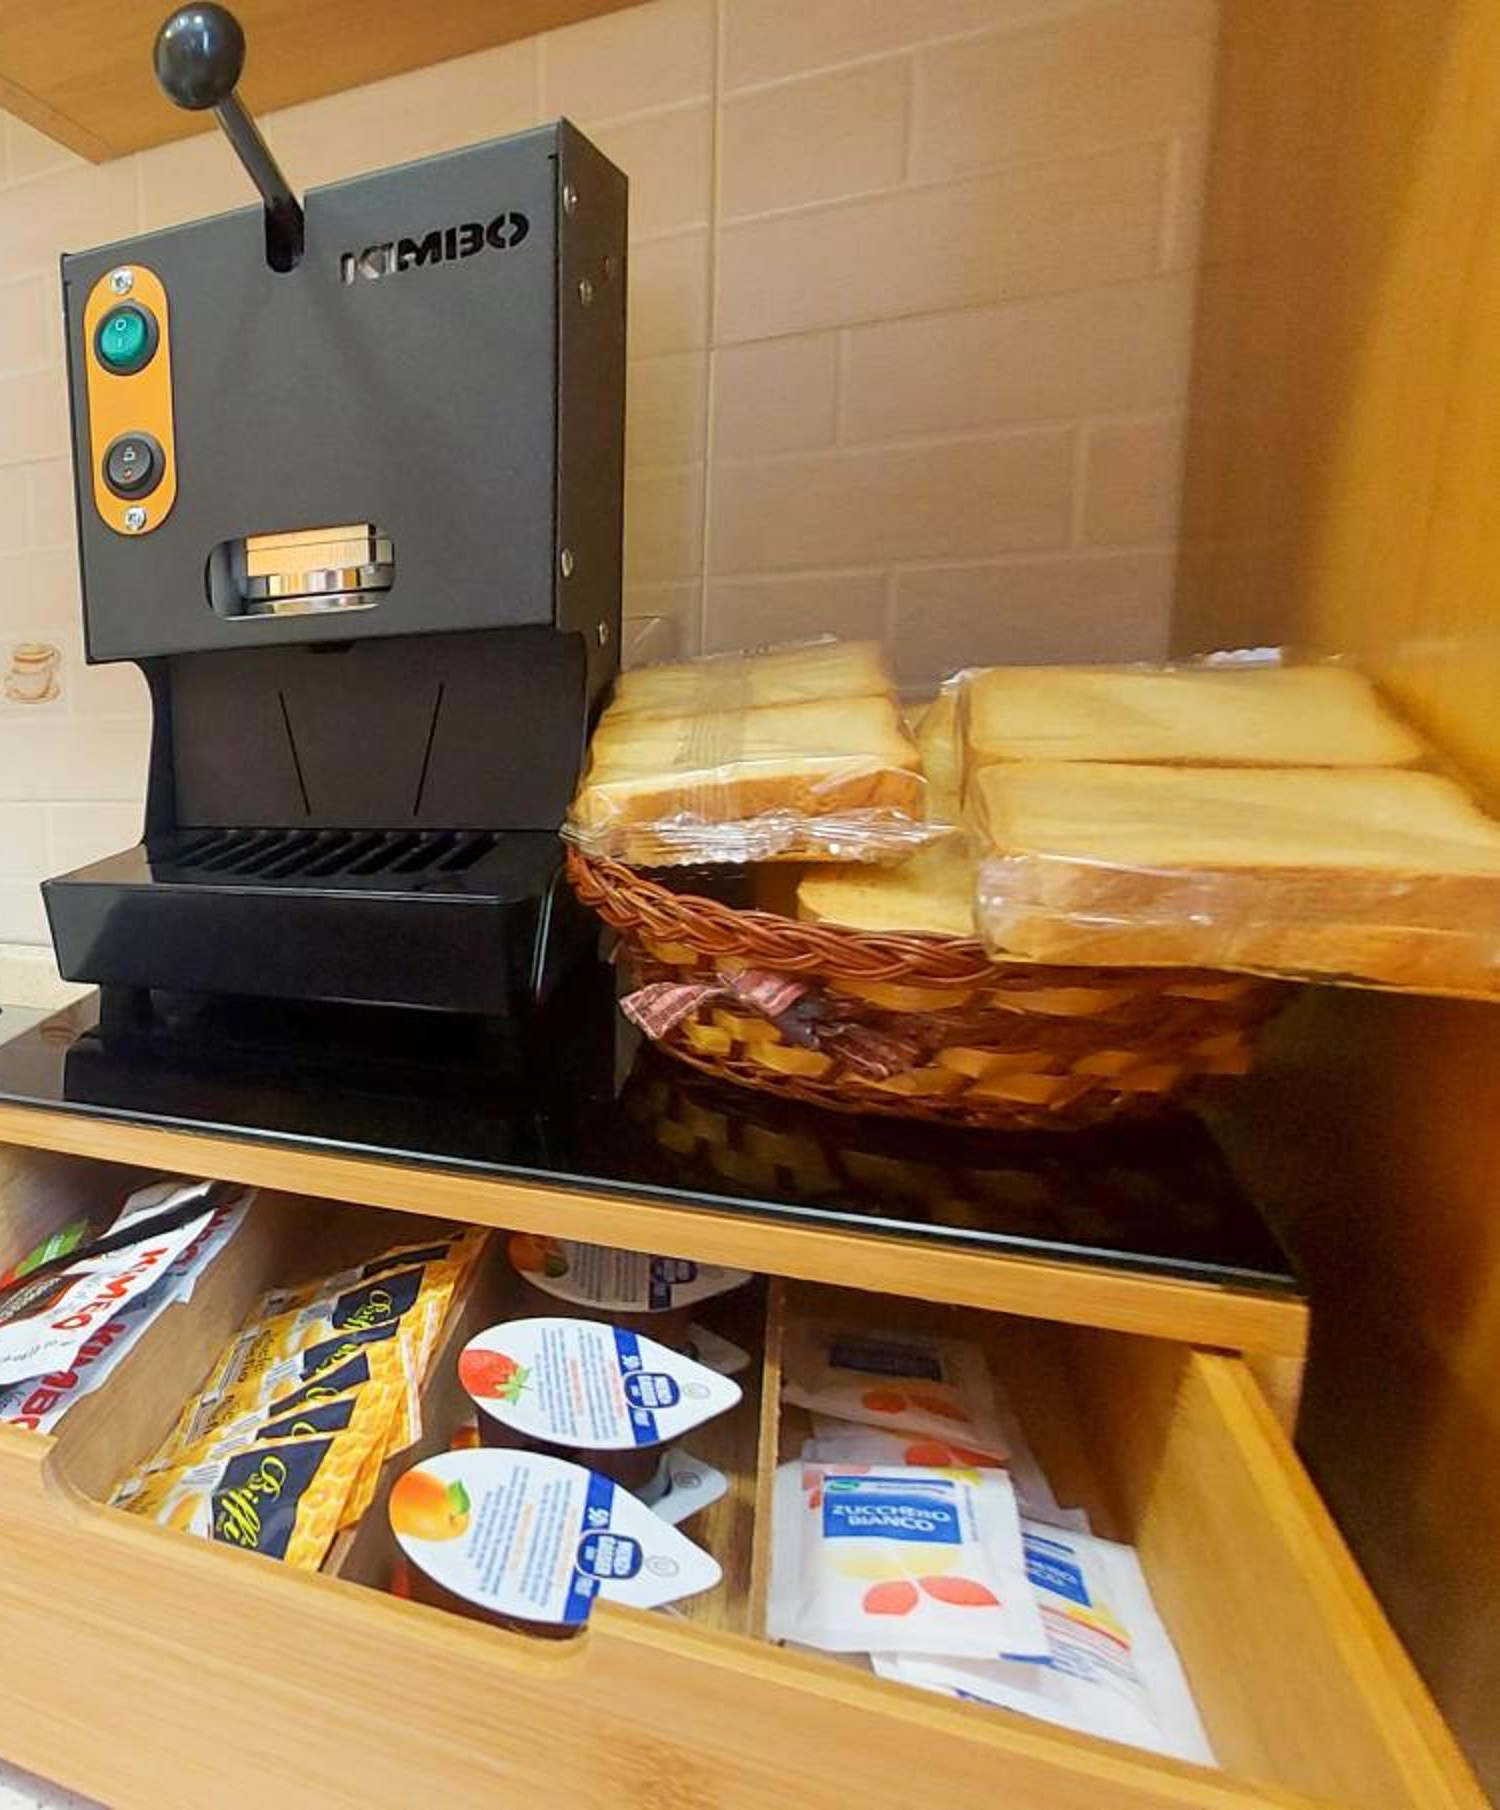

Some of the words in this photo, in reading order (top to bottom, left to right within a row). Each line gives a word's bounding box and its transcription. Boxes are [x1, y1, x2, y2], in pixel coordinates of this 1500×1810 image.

[340, 211, 530, 285] KIMBO
[221, 1455, 287, 1548] Biffi
[832, 1504, 951, 1523] ZUCCHERO
[847, 1515, 936, 1532] BIANCO
